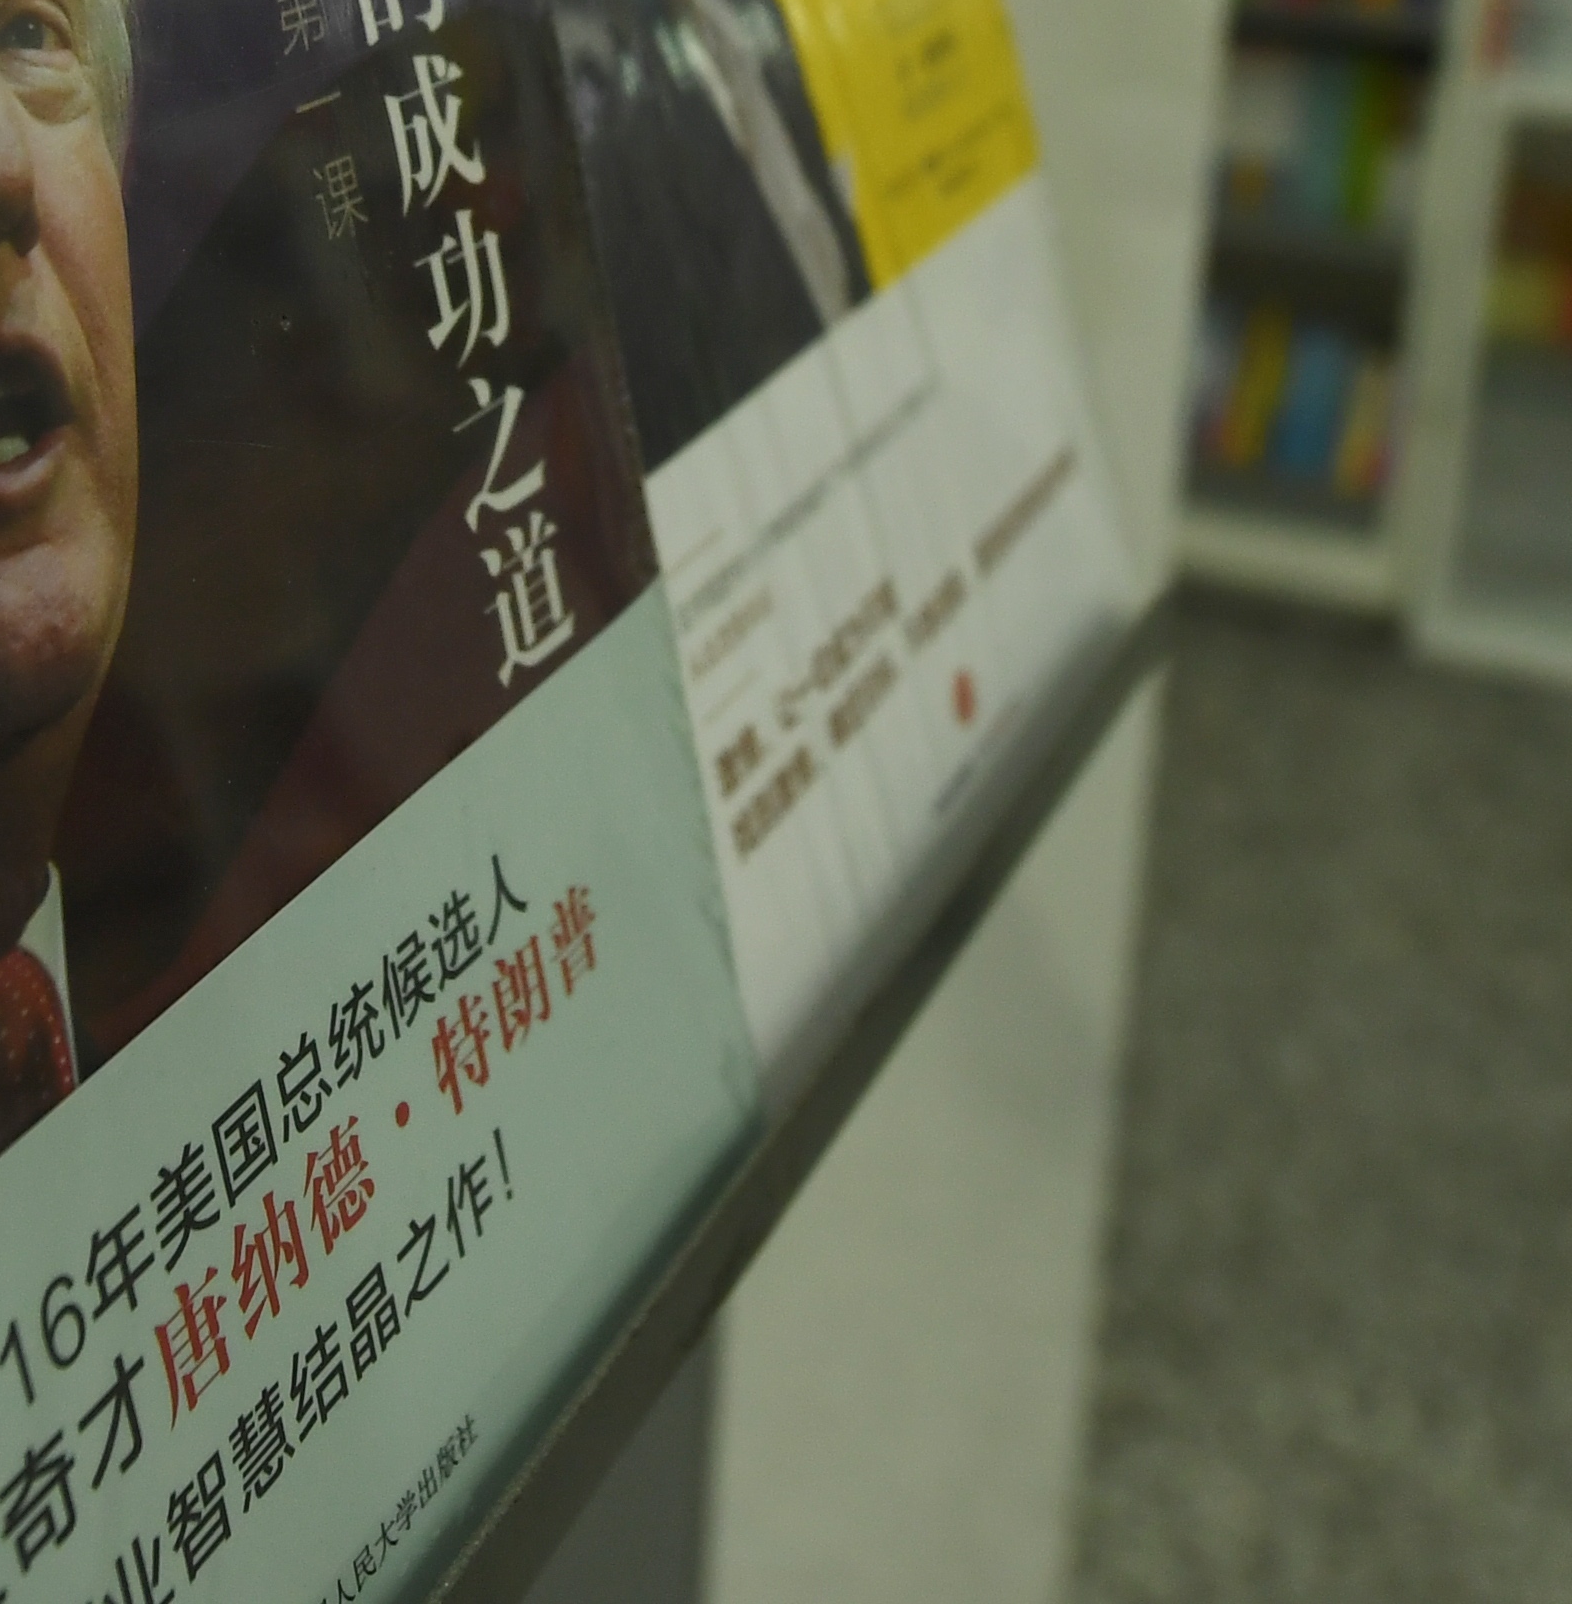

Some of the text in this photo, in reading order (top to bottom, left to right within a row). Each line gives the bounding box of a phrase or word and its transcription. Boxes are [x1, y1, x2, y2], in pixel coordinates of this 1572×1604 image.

[83, 1126, 516, 1604] 业智慧结晶之作！
[318, 1412, 479, 1604] 人民大学出版社
